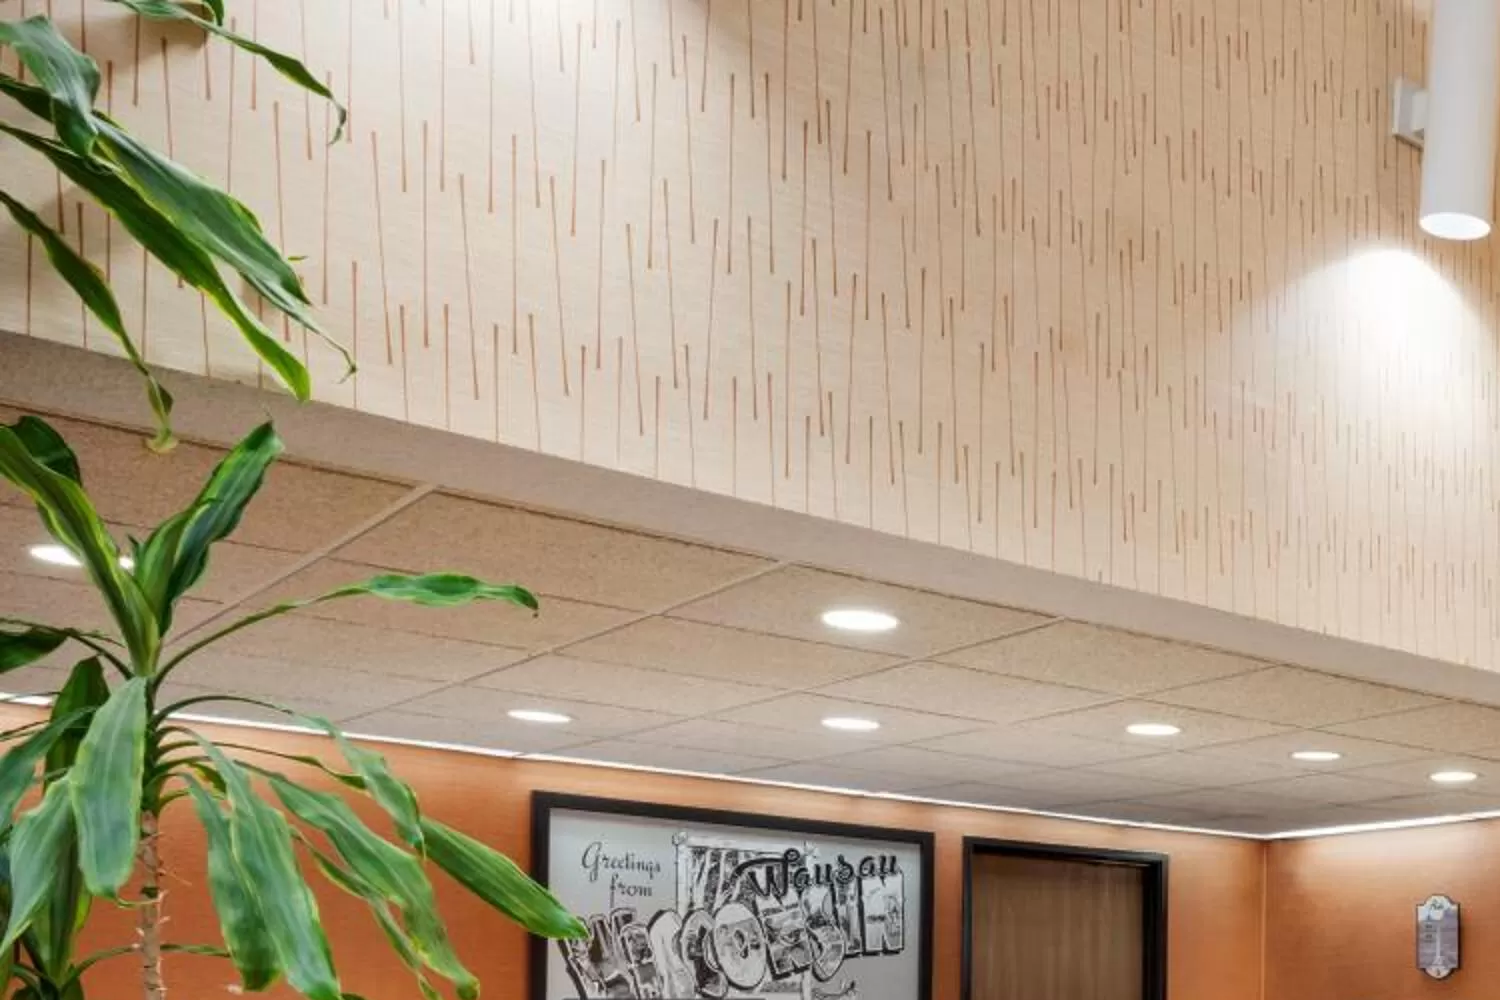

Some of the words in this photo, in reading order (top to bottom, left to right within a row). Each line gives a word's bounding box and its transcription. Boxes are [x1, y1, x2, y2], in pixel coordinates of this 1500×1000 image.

[582, 840, 662, 882] Greetings
[724, 847, 899, 898] Wausau
[610, 872, 653, 905] from
